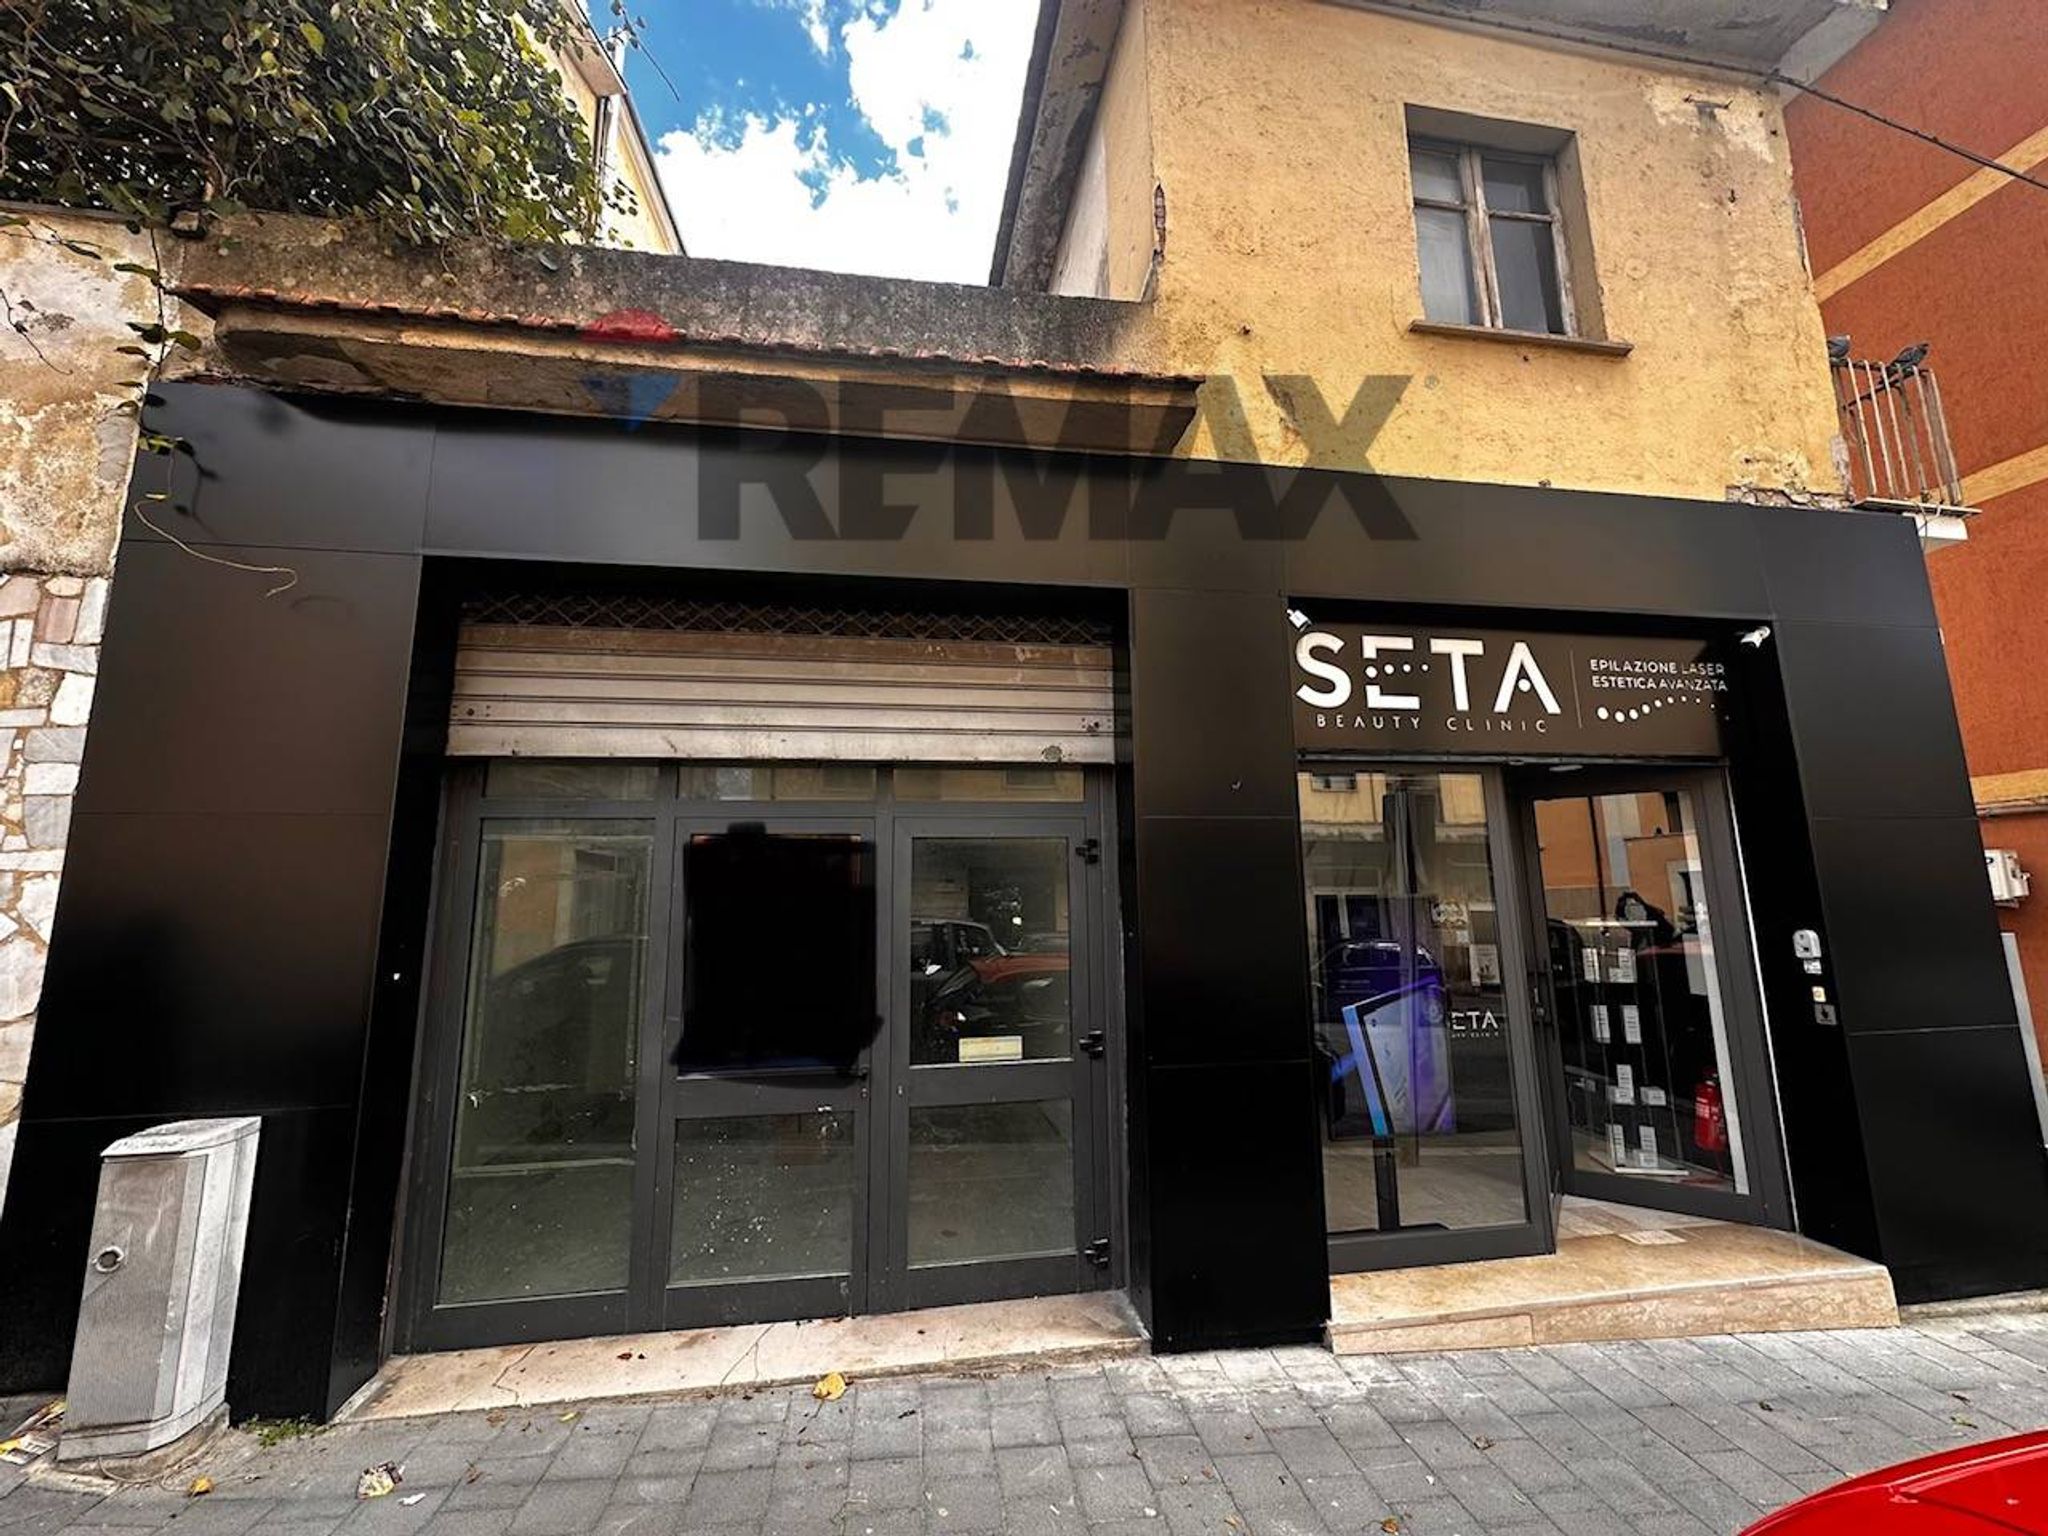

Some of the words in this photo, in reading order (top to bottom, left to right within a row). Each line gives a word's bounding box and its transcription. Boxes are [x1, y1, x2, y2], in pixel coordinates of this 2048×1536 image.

[1295, 631, 1561, 714] SETA
[1590, 659, 1678, 675] EPILAZIONE
[1682, 663, 1726, 676] LASER
[1592, 676, 1656, 691] ESTETICA
[1657, 678, 1728, 692] AVANZATA
[1316, 714, 1422, 730] BEAUTY
[1446, 717, 1548, 734] CLINIC
